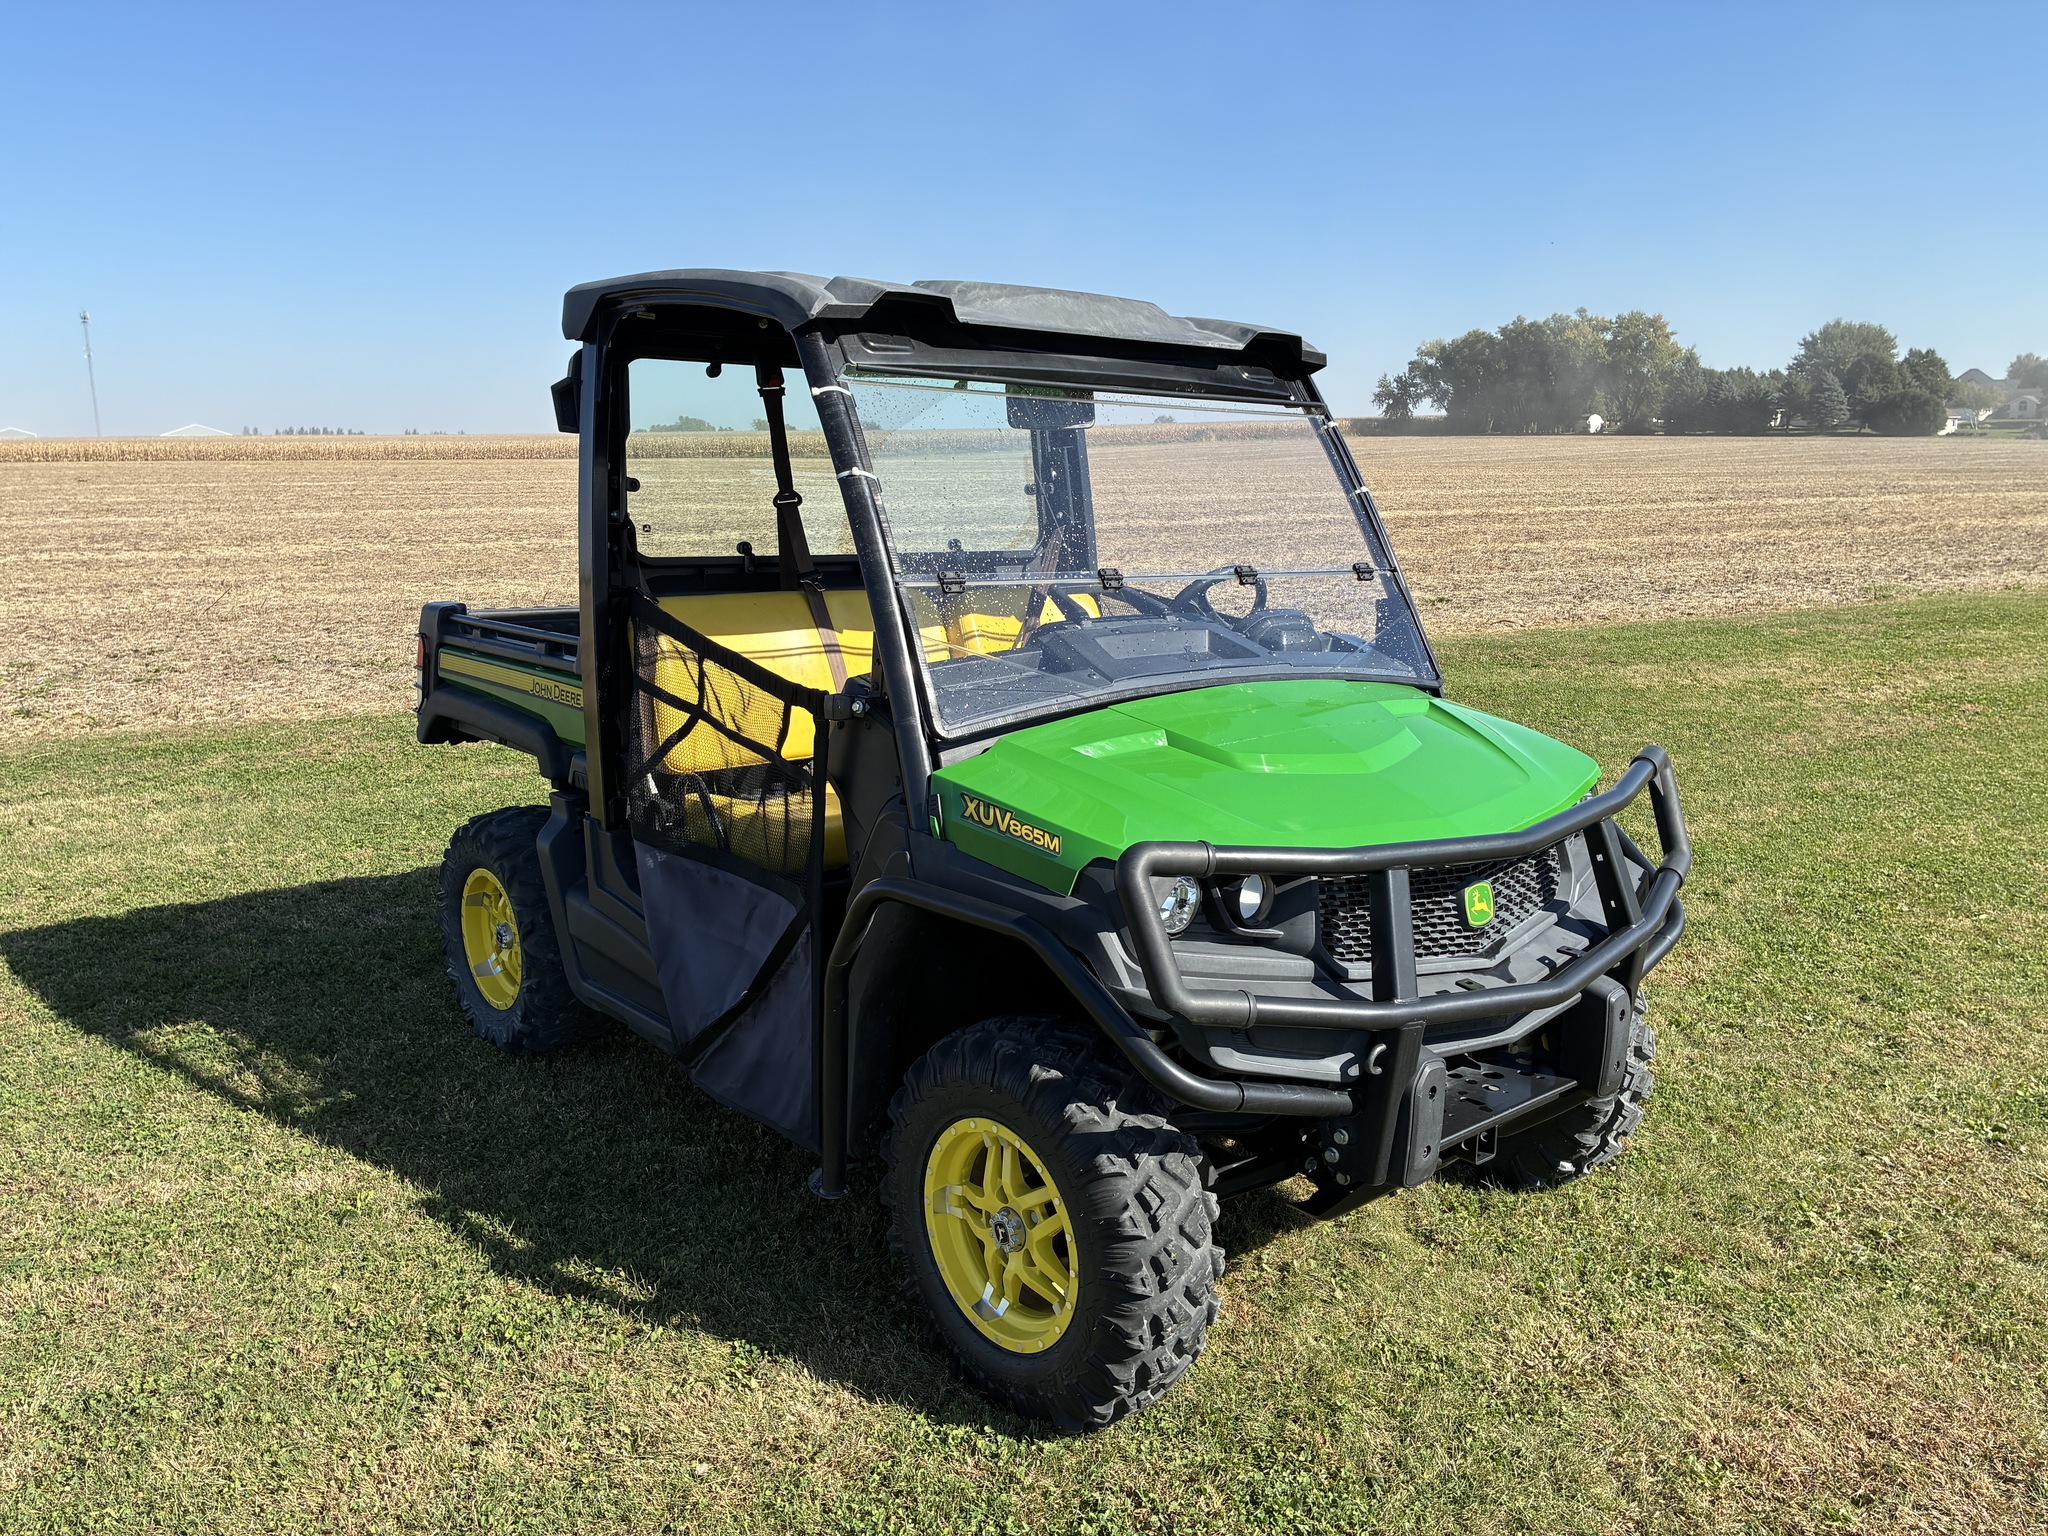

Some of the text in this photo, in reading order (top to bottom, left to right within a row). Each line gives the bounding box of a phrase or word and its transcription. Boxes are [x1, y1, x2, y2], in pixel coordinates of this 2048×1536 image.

[529, 678, 582, 706] JOHN DEERE
[962, 794, 1061, 854] XUV865M
